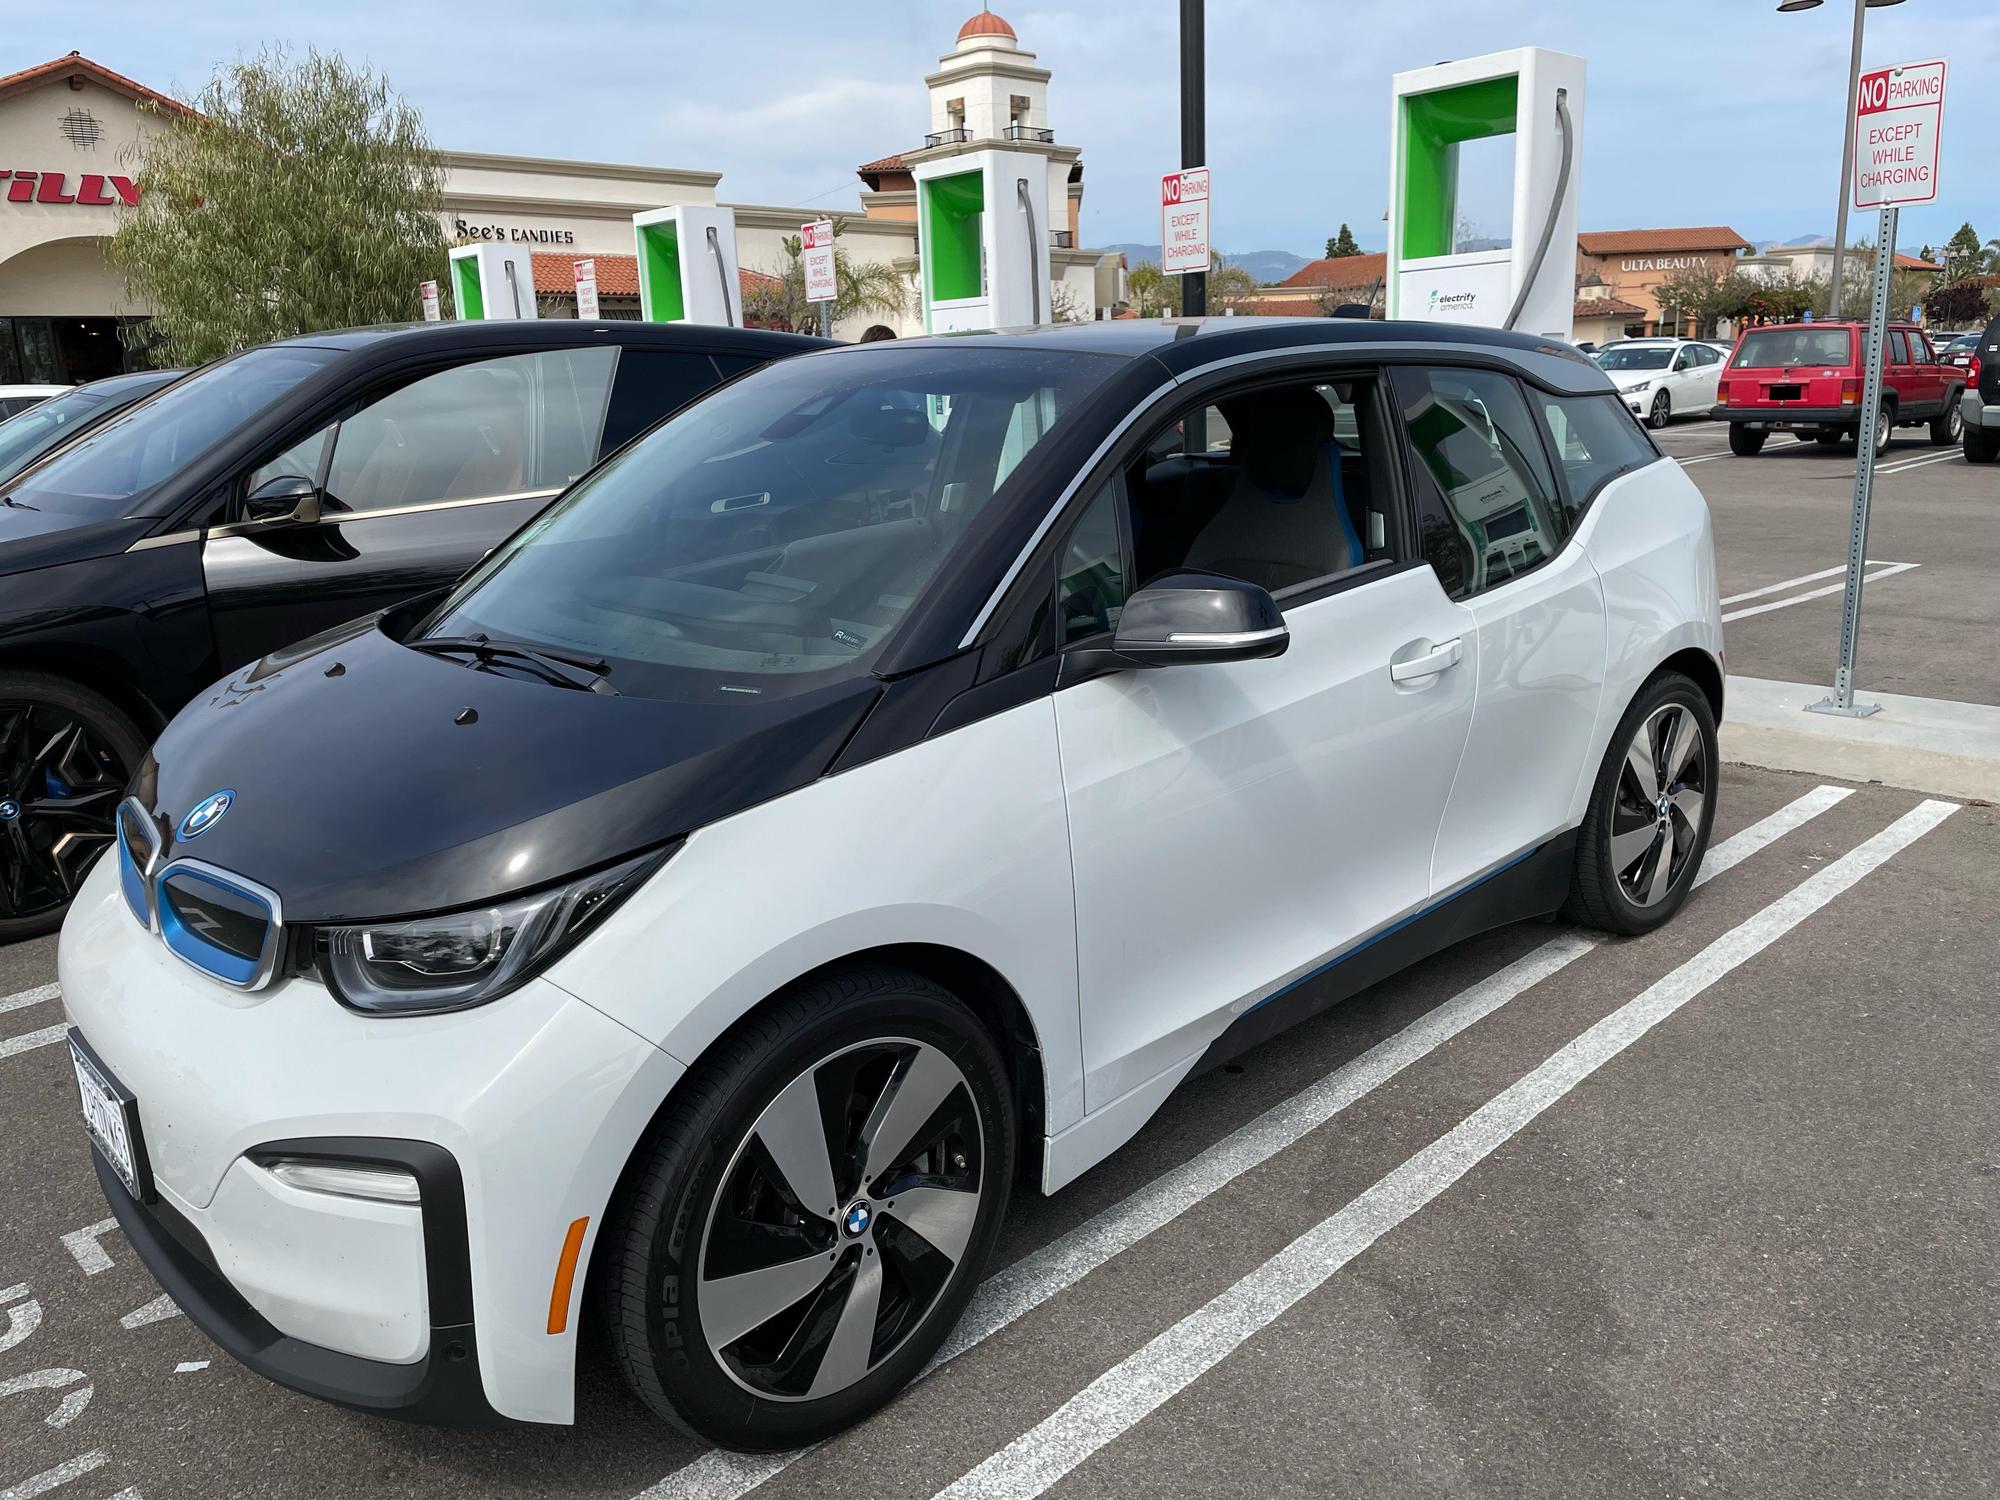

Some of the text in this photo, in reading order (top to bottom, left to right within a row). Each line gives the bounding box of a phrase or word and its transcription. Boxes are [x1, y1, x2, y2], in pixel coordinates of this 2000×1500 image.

[1860, 76, 1939, 110] NO PARKING
[1869, 123, 1922, 145] EXCEPT
[1872, 146, 1914, 165] WHILE
[1860, 165, 1929, 188] CHARGING
[1163, 179, 1207, 202] NO PARKING
[1171, 213, 1200, 228] EXCEPT
[456, 220, 573, 244] See's CANDIES
[803, 229, 815, 247] NO
[1174, 229, 1197, 242] WHILE
[1167, 243, 1206, 259] CHARGING
[1621, 256, 1709, 272] ULTA BEAUTY
[1439, 292, 1476, 303] electrify
